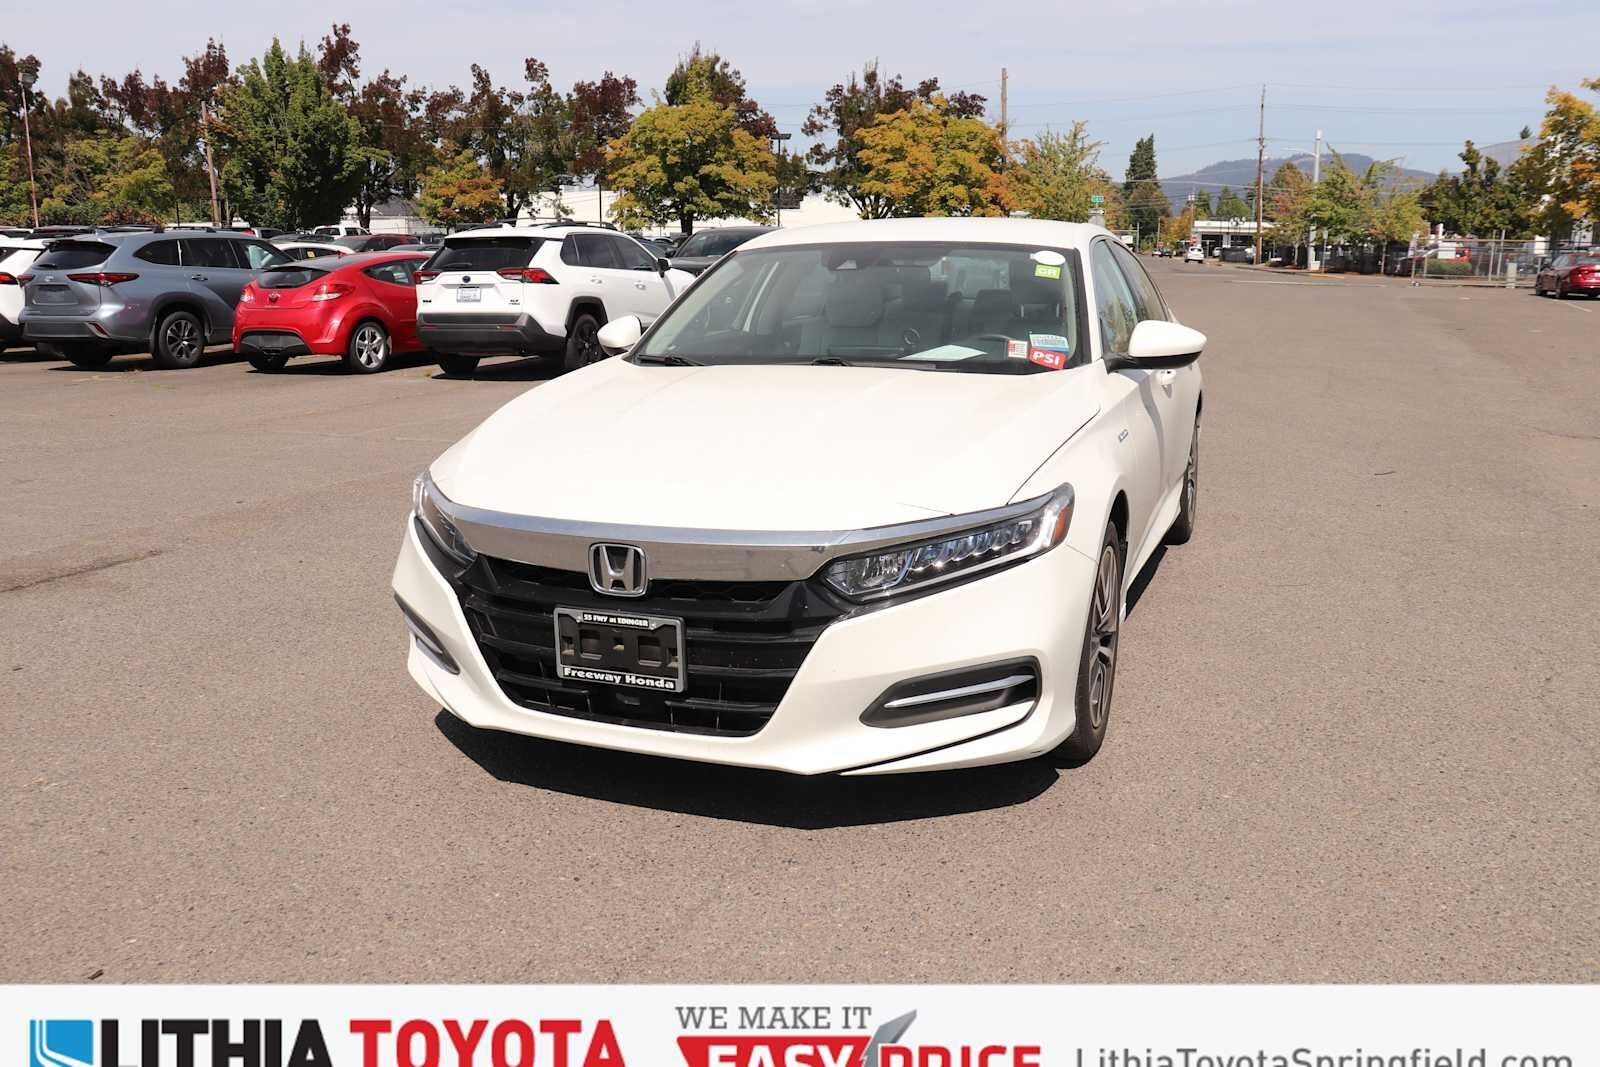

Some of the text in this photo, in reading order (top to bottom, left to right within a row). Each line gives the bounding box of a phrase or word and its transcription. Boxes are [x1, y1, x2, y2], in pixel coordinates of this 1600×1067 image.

[1033, 351, 1060, 365] PSI
[618, 617, 648, 626] EDINGER
[564, 667, 675, 689] Freeway Honda
